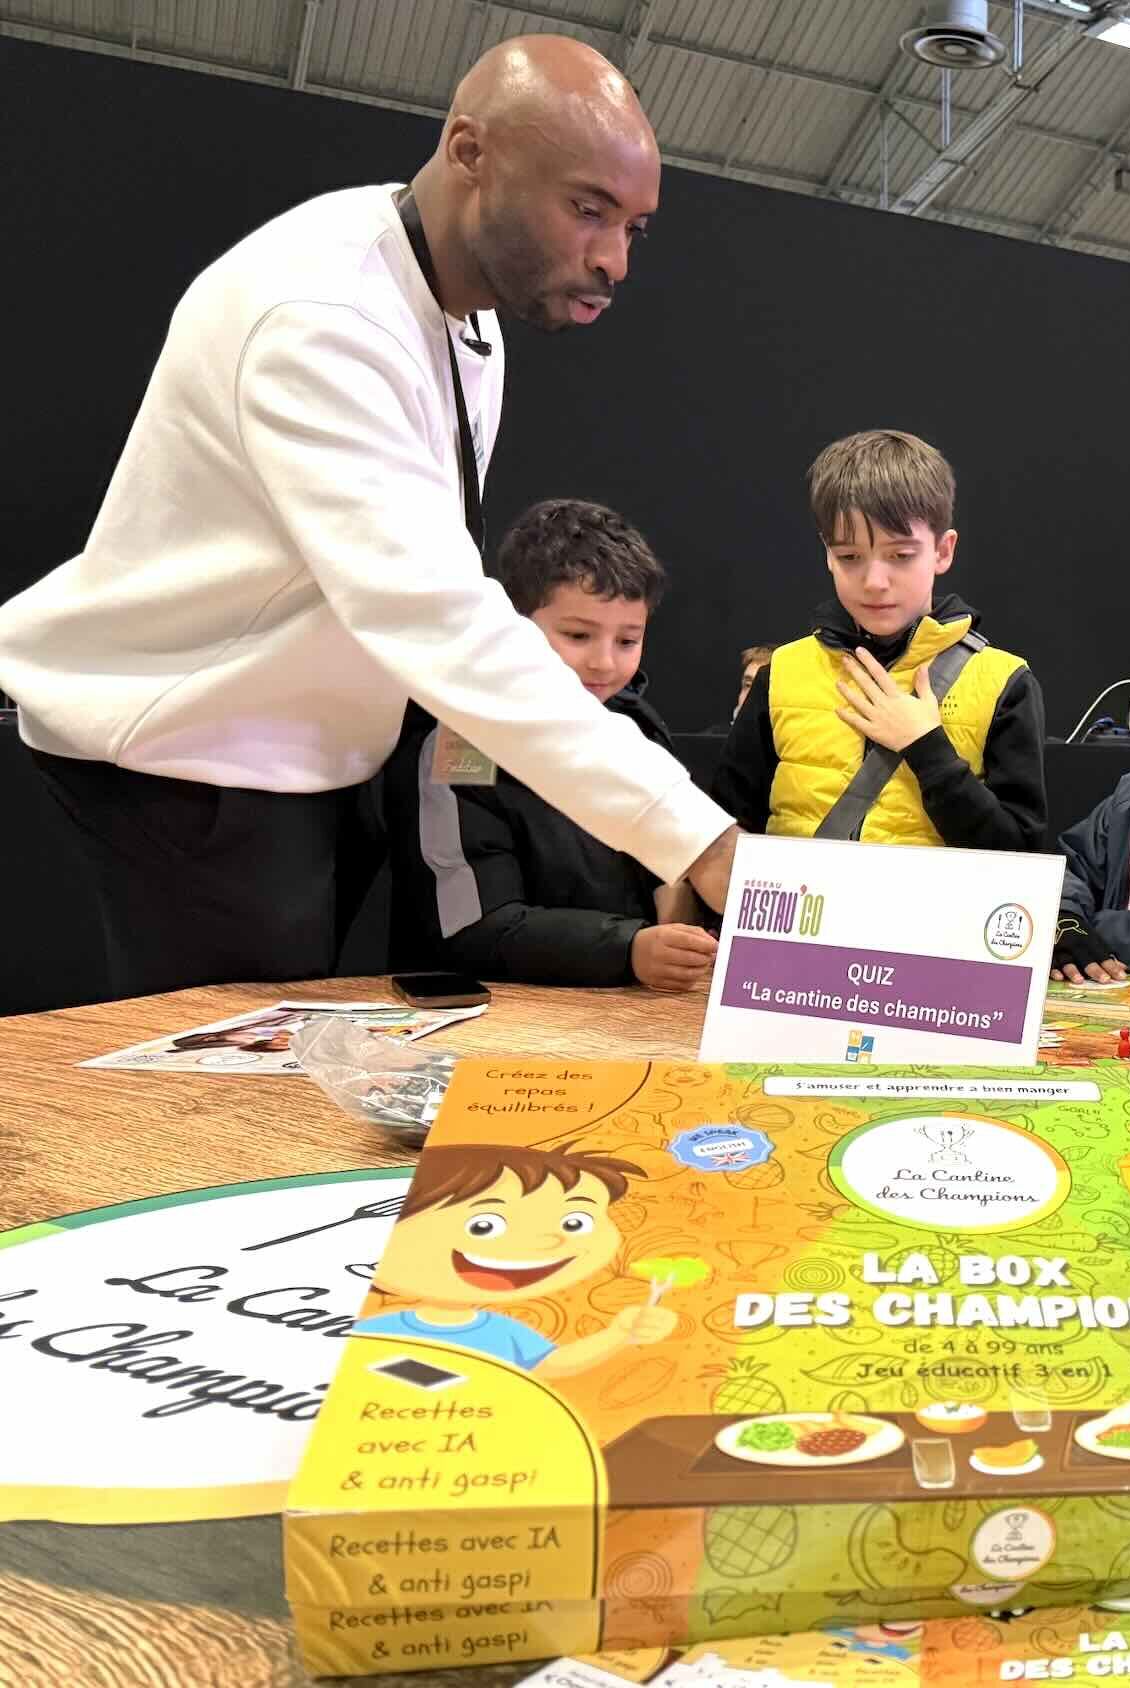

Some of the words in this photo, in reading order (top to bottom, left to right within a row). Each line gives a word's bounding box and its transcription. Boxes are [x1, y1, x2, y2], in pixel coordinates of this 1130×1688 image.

[846, 962, 895, 986] QUIZ
[774, 986, 843, 1012] cantine
[846, 993, 880, 1016] des
[486, 1068, 549, 1081] Créez
[555, 1068, 593, 1081] des
[504, 1087, 567, 1099] repas
[866, 1083, 882, 1092] et
[887, 1083, 966, 1095] apprendre
[1017, 1087, 1070, 1098] manger
[466, 1099, 580, 1115] équilibrés
[892, 1168, 925, 1182] La
[931, 1168, 1016, 1184] Cantine
[876, 1187, 912, 1200] des
[919, 1187, 1039, 1207] Champions
[862, 1252, 939, 1287] LA
[957, 1256, 1072, 1290] BOX
[103, 1265, 229, 1302] La
[733, 1293, 852, 1330] DES
[904, 1341, 933, 1354] de
[941, 1341, 955, 1353] 4
[965, 1340, 979, 1354] à
[984, 1341, 1018, 1355] 99
[1025, 1343, 1064, 1355] ans
[30, 1323, 330, 1421] Champio
[856, 1363, 903, 1378] Jeu
[915, 1359, 1020, 1378] éducatif
[1034, 1364, 1051, 1377] 3
[1062, 1366, 1090, 1378] en
[359, 1401, 494, 1421] Recettes
[357, 1440, 427, 1454] avec
[436, 1432, 477, 1453] IA
[340, 1471, 364, 1491] &
[377, 1470, 441, 1489] anti
[450, 1469, 539, 1497] gaspi
[328, 1531, 450, 1558] Recettes
[459, 1537, 517, 1551] avec
[526, 1526, 562, 1549] IA
[368, 1573, 388, 1595] &
[399, 1571, 450, 1594] anti
[460, 1569, 532, 1599] gaspi
[328, 1603, 445, 1632] Recettes
[455, 1603, 514, 1618] avec
[371, 1640, 392, 1660] &
[401, 1637, 451, 1657] anti
[461, 1629, 529, 1657] gaspi
[1078, 1633, 1128, 1653] LA
[1000, 1657, 1074, 1682] DES
